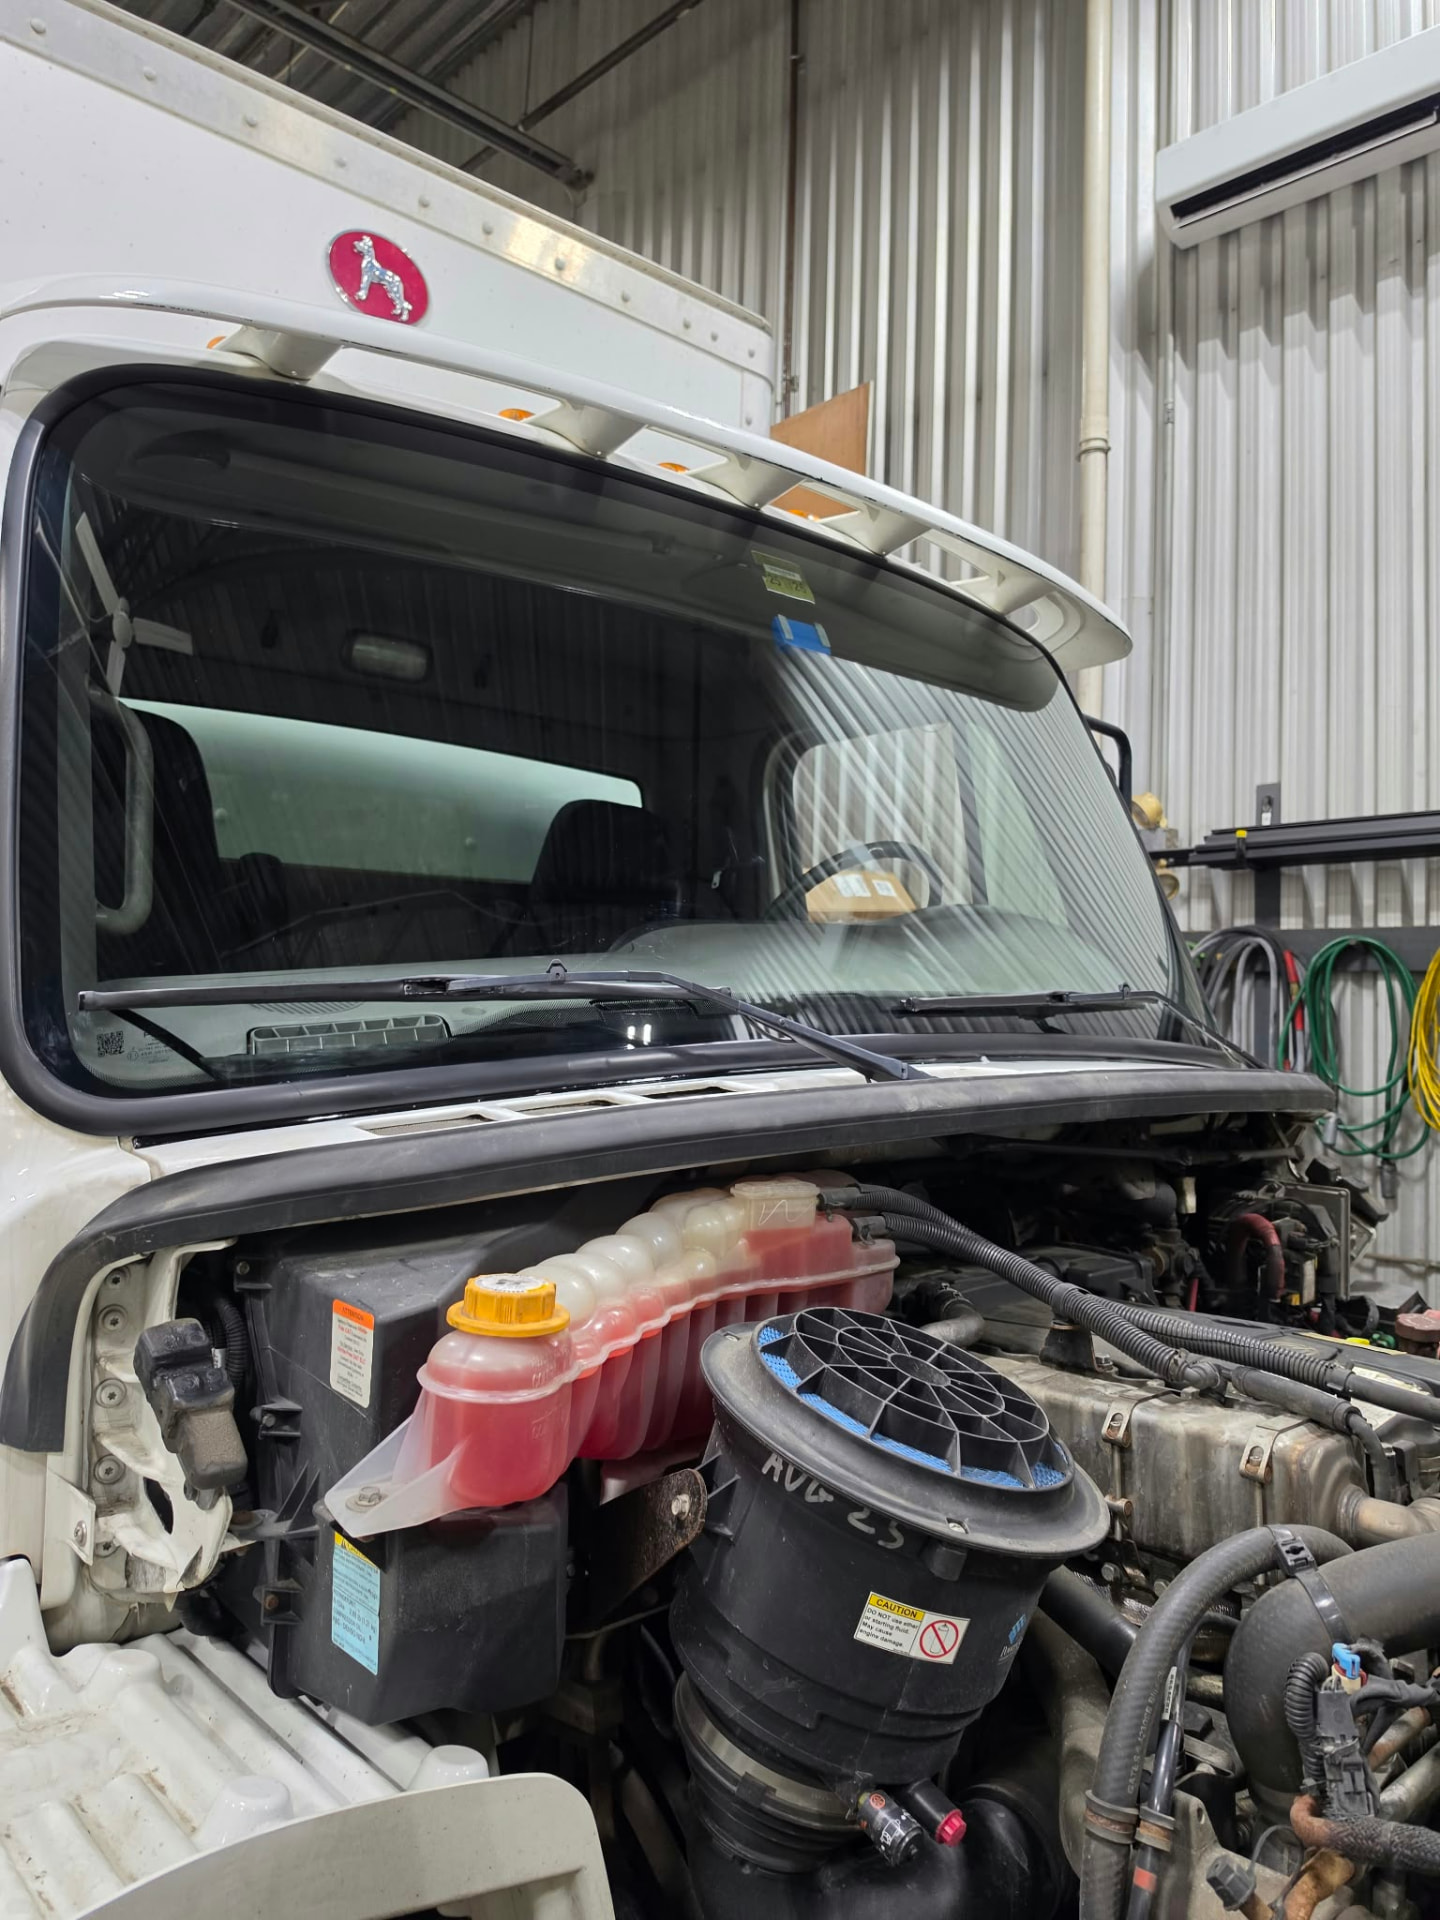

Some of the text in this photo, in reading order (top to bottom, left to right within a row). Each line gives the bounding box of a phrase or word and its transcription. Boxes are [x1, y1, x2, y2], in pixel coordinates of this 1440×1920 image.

[761, 1452, 835, 1503] AUG
[867, 1607, 877, 1615] DO
[878, 1611, 891, 1620] NOT
[876, 1598, 918, 1619] CAUTION
[862, 1620, 892, 1636] May cause
[872, 1618, 895, 1630] starting
[860, 1628, 879, 1639] engine
